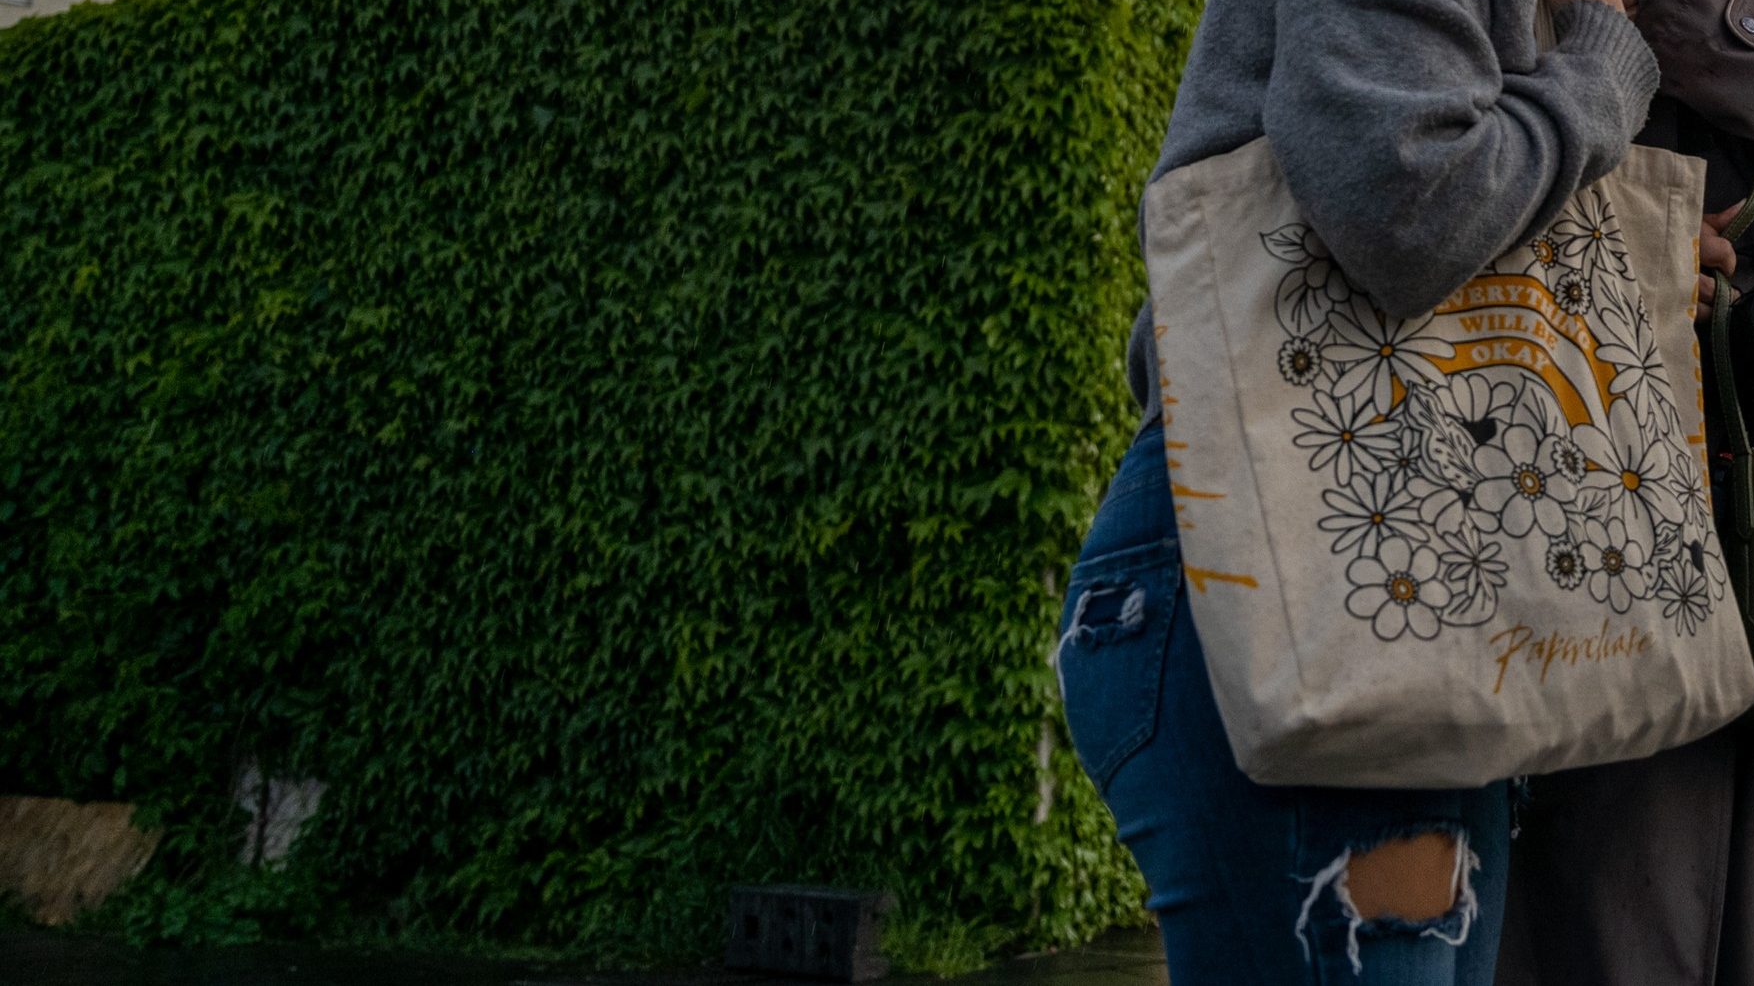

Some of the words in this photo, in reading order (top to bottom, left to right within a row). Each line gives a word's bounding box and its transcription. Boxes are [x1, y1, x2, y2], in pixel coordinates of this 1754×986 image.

[1438, 283, 1592, 351] VERYTHING
[1459, 315, 1528, 334] WILL
[1533, 321, 1559, 350] BE
[1471, 342, 1549, 371] OKAY
